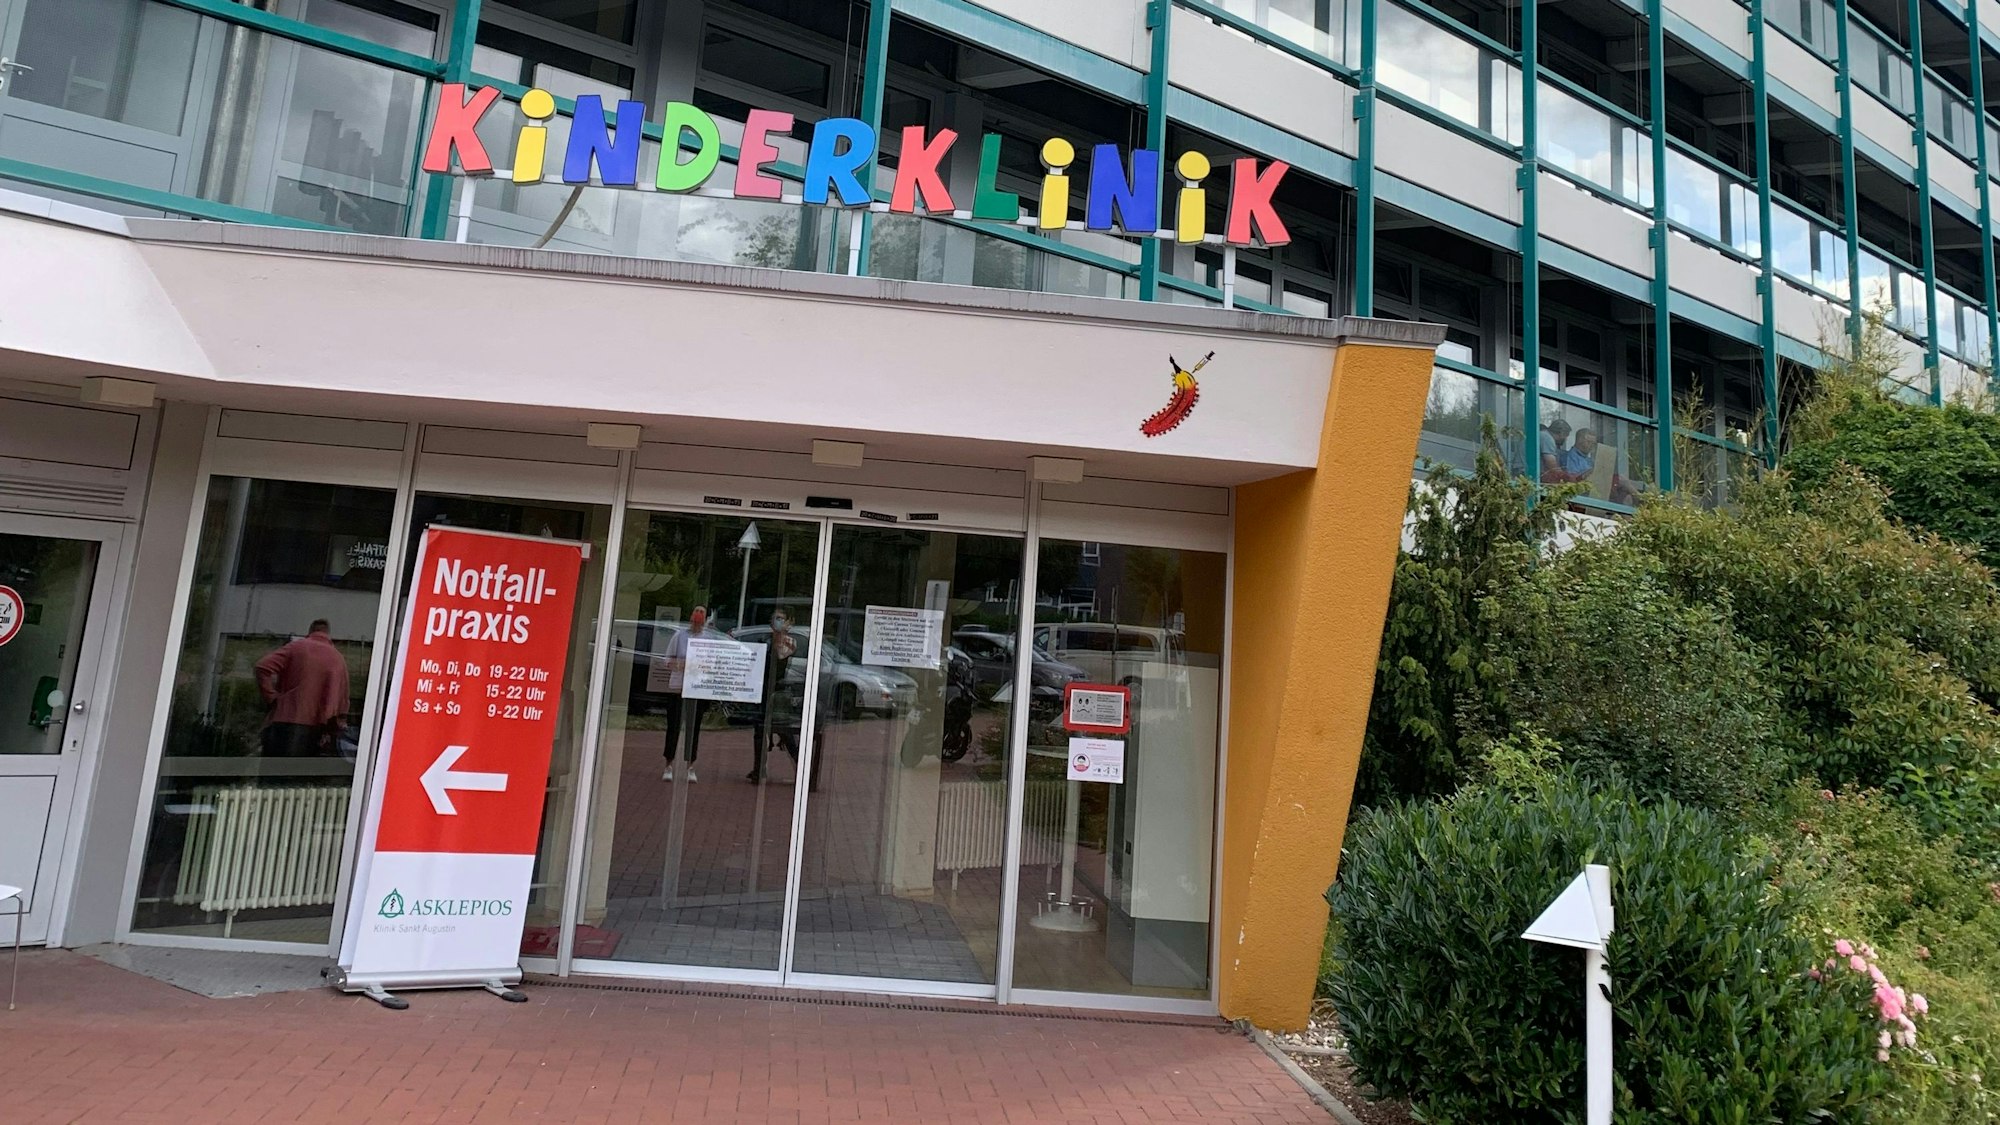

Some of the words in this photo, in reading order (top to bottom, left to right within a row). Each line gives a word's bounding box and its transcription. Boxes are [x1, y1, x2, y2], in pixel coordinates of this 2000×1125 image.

[433, 558, 556, 604] Notfall-
[424, 604, 530, 645] praxis
[420, 658, 442, 677] Mo,
[446, 660, 461, 678] Di,
[464, 662, 481, 677] Do
[529, 667, 549, 682] Uhr
[416, 678, 433, 694] Mi
[436, 683, 446, 694] +
[448, 680, 461, 695] Fr
[525, 686, 547, 701] Uhr
[412, 698, 430, 713] Sa
[433, 703, 443, 714] +
[445, 700, 461, 715] So
[522, 705, 544, 720] Uhr
[409, 899, 513, 916] ASKLEPIOS
[399, 925, 421, 933] Sankt
[422, 924, 456, 934] Augustin
